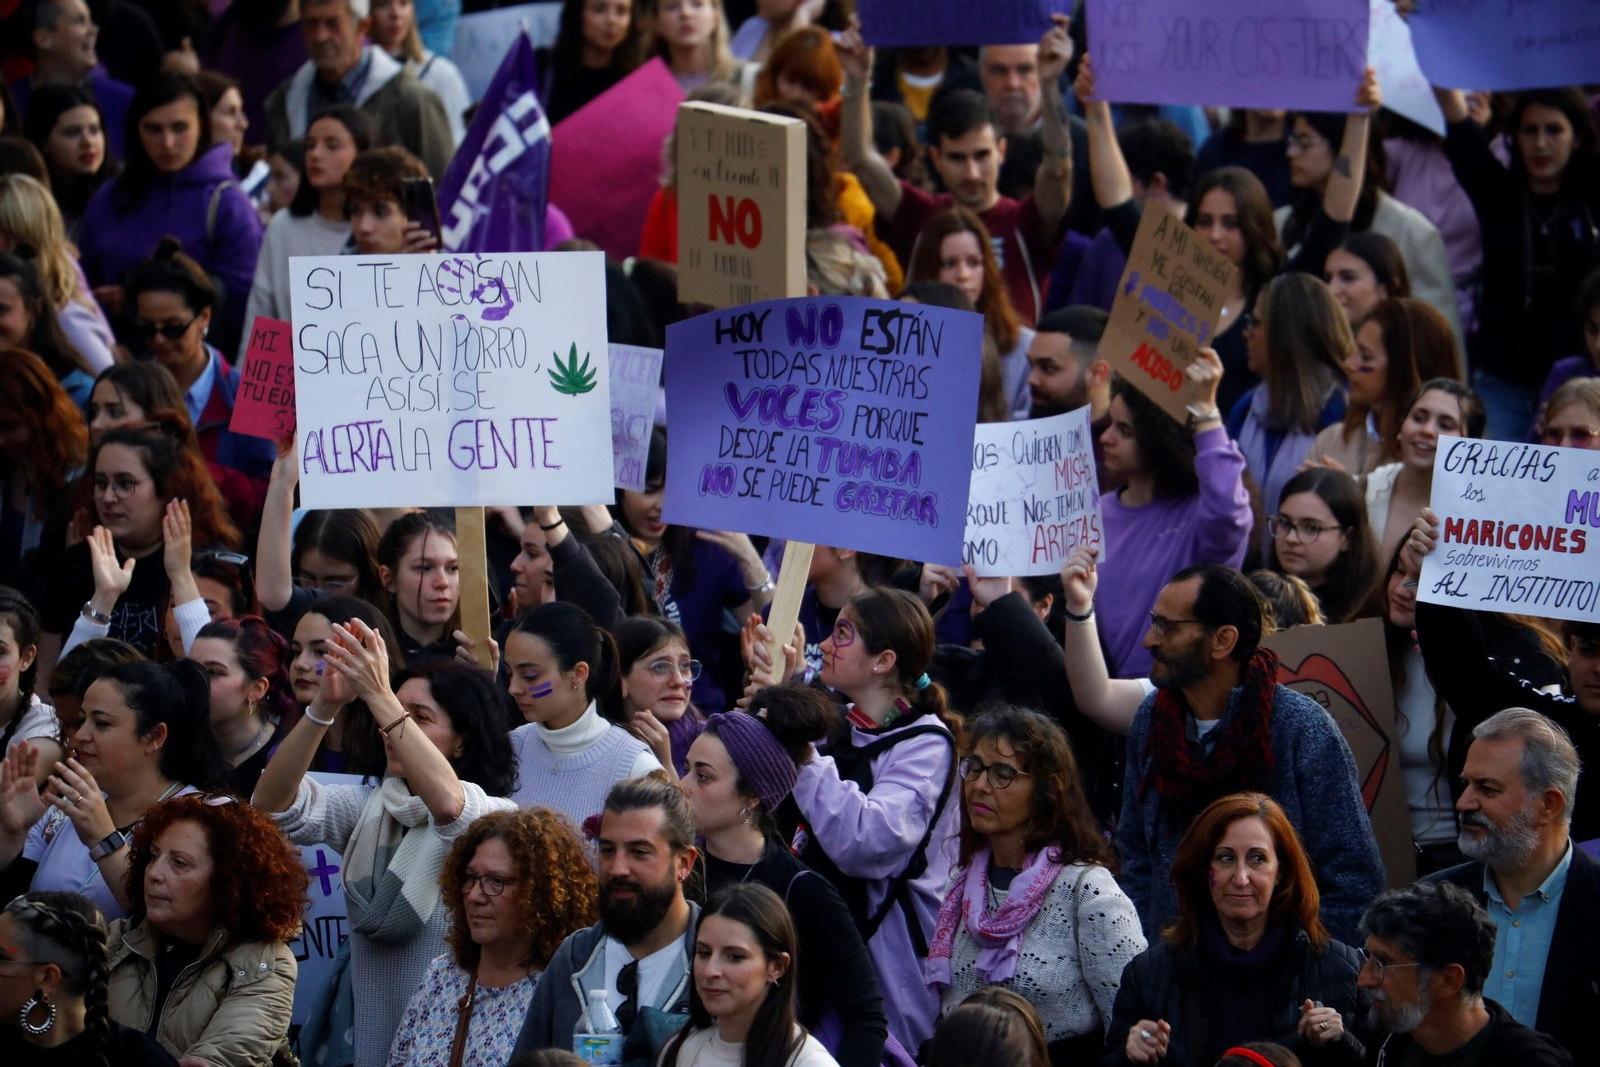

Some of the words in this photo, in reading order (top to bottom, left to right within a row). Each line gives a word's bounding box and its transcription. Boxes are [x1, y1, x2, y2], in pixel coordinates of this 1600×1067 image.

[1156, 15, 1222, 73] YOUR
[708, 193, 763, 250] NO
[1153, 214, 1168, 239] A
[1169, 227, 1188, 256] MI
[305, 266, 343, 311] SI
[356, 262, 404, 308] TE
[416, 259, 542, 307] ACOSAN
[1151, 247, 1168, 280] ME
[1172, 264, 1215, 311] GUSTAN
[251, 327, 281, 352] MI
[299, 321, 384, 375] SACA
[394, 319, 442, 374] UN
[714, 308, 772, 345] HOY
[784, 303, 844, 350] NO
[860, 307, 945, 359] ESTÁN
[244, 358, 271, 382] NO
[610, 346, 660, 387] MUJER
[733, 348, 822, 387] TODAS
[824, 354, 932, 400] NUESTRAS
[1130, 341, 1183, 393] ACOSO
[242, 380, 266, 402] TU
[723, 381, 849, 434] VOCES
[851, 404, 929, 446] PORQUE
[303, 419, 396, 475] ALERTA
[399, 417, 432, 471] LA
[448, 417, 562, 471] GENTE
[718, 424, 784, 464] DESDE
[786, 434, 810, 470] LA
[813, 436, 922, 488] TUMBA
[972, 442, 1000, 472] OS
[619, 457, 641, 487] 8M
[698, 462, 738, 499] NO
[737, 466, 766, 499] SE
[767, 471, 831, 507] PUEDE
[834, 481, 939, 529] GRITAR
[1054, 453, 1092, 492] MUSAS
[1460, 482, 1486, 503] los
[1587, 468, 1600, 482] a
[1055, 489, 1085, 522] TEMEN
[1431, 571, 1469, 598] AL
